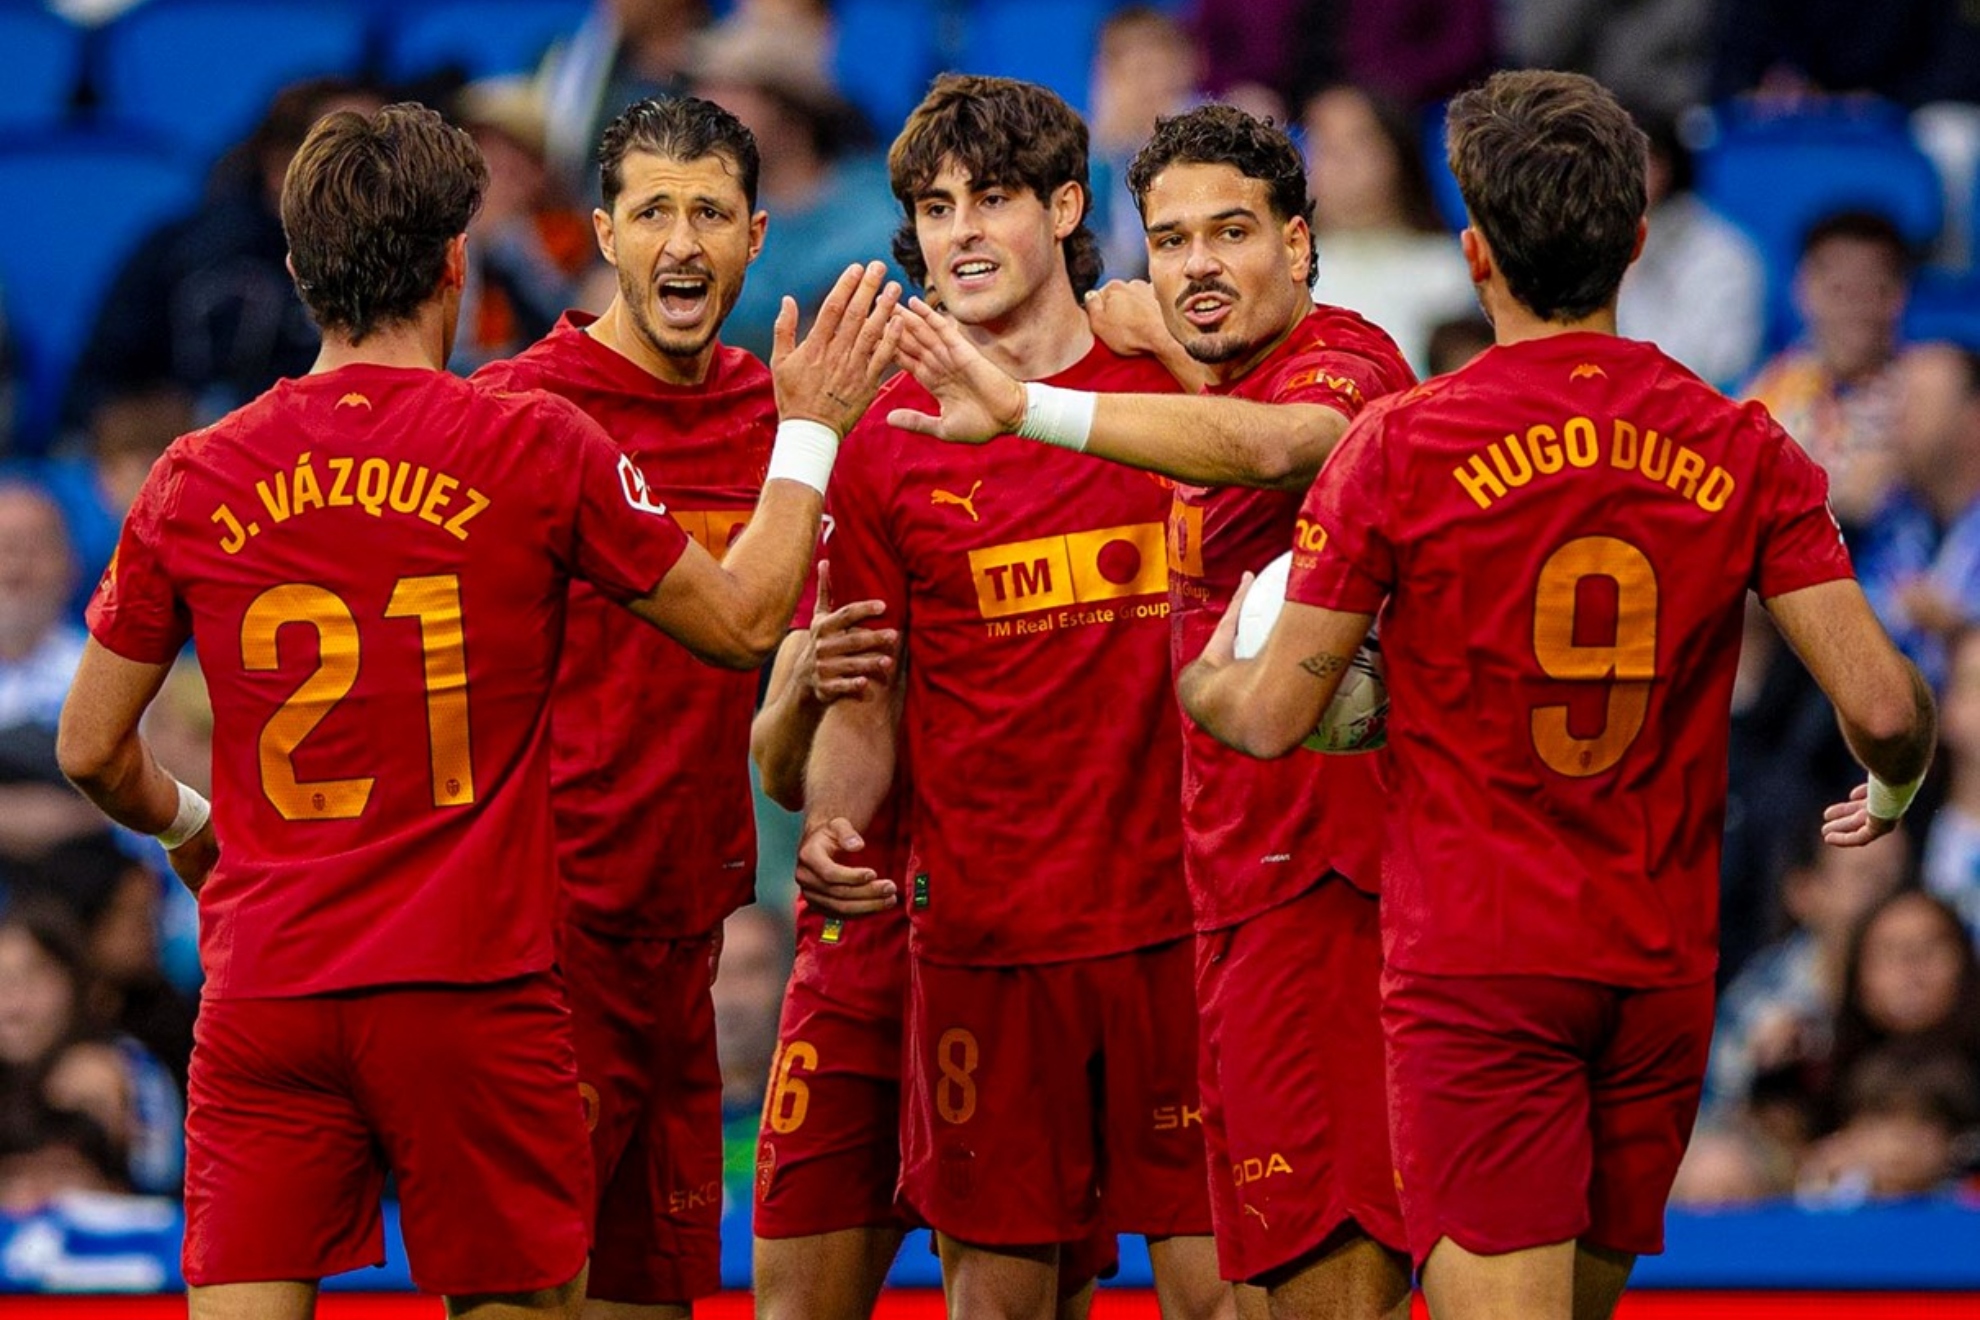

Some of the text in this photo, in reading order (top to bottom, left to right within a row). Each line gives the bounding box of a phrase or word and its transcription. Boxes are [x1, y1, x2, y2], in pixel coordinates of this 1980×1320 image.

[1452, 417, 1735, 512] HUGO DURO
[210, 451, 491, 554] J. VÁZQUEZ
[1296, 519, 1328, 552] na
[984, 558, 1053, 602] TM
[985, 601, 1171, 637] TM Real Estate Group
[1531, 536, 1658, 777] 9
[241, 574, 474, 820] 21
[937, 1028, 979, 1124] 8
[1153, 1105, 1203, 1130] SK
[1233, 1153, 1294, 1187] ODA
[669, 1181, 720, 1214] SKO
